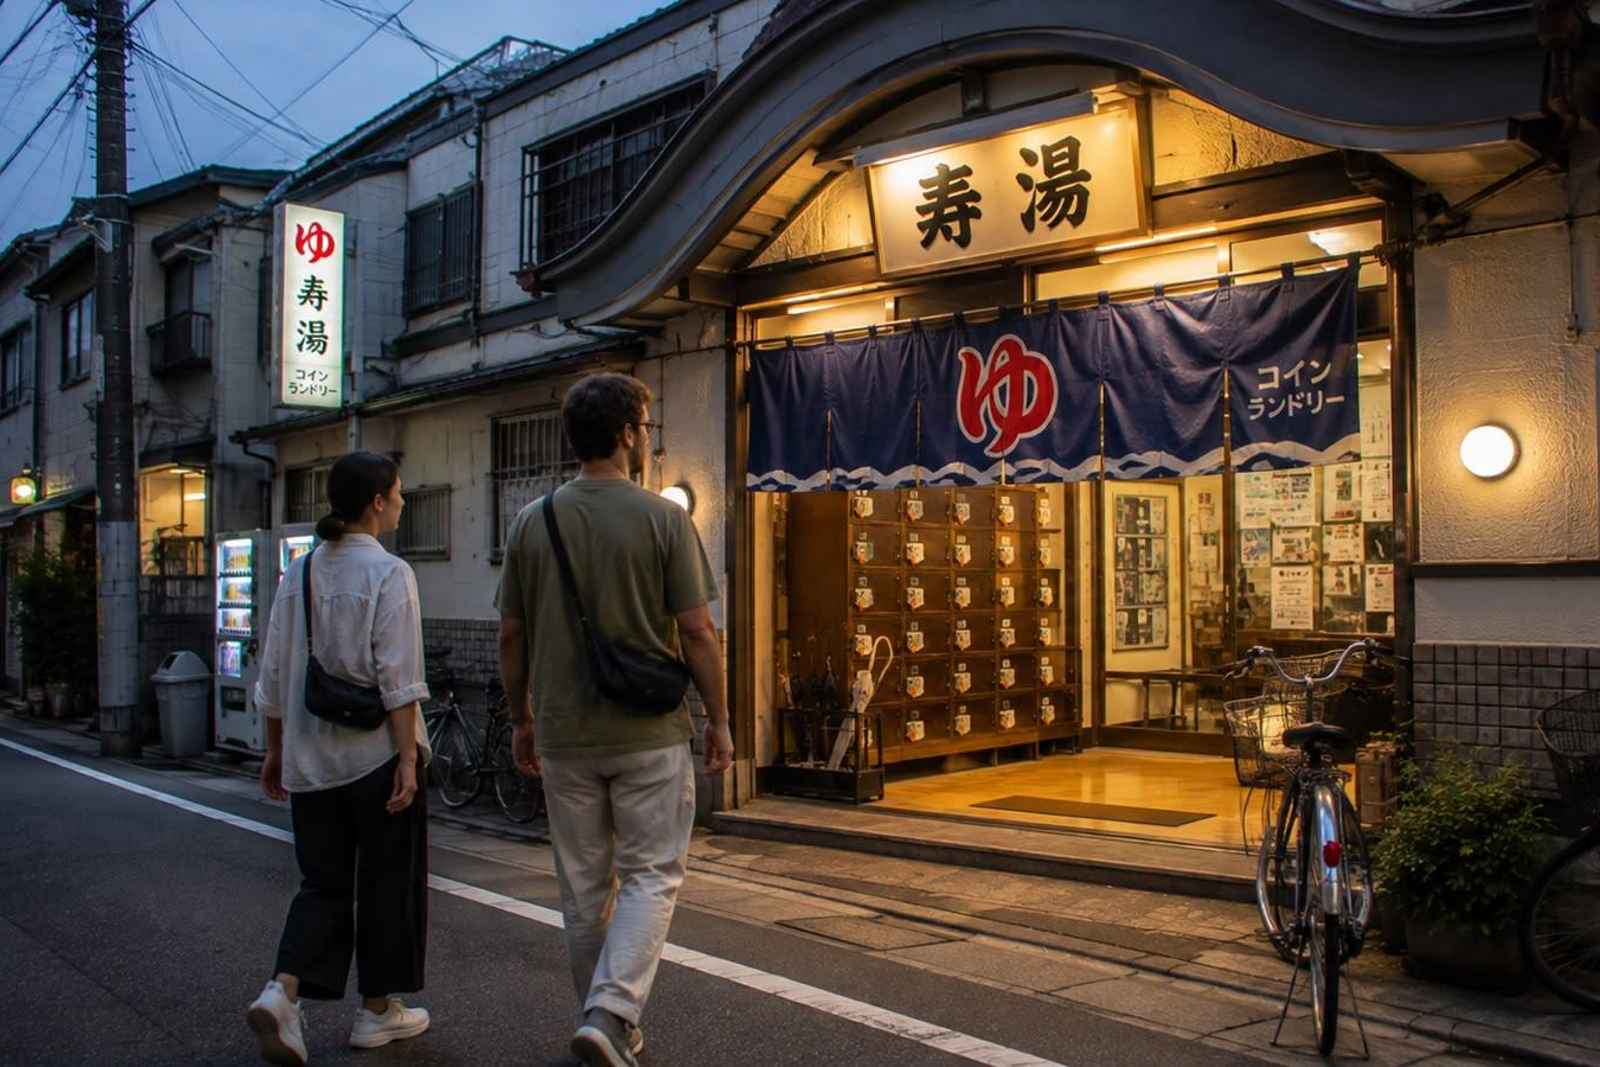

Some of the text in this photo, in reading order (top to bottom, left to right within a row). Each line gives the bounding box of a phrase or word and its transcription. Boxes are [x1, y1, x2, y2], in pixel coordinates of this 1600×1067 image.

[915, 135, 1092, 249] 寿湯
[295, 222, 335, 263] ゆ
[296, 275, 329, 355] 寿湯
[289, 382, 337, 397] ランドリー
[296, 369, 328, 382] コイン
[1258, 360, 1332, 390] コイン
[957, 334, 1058, 457] ゆ
[1247, 390, 1345, 421] ランドリー
